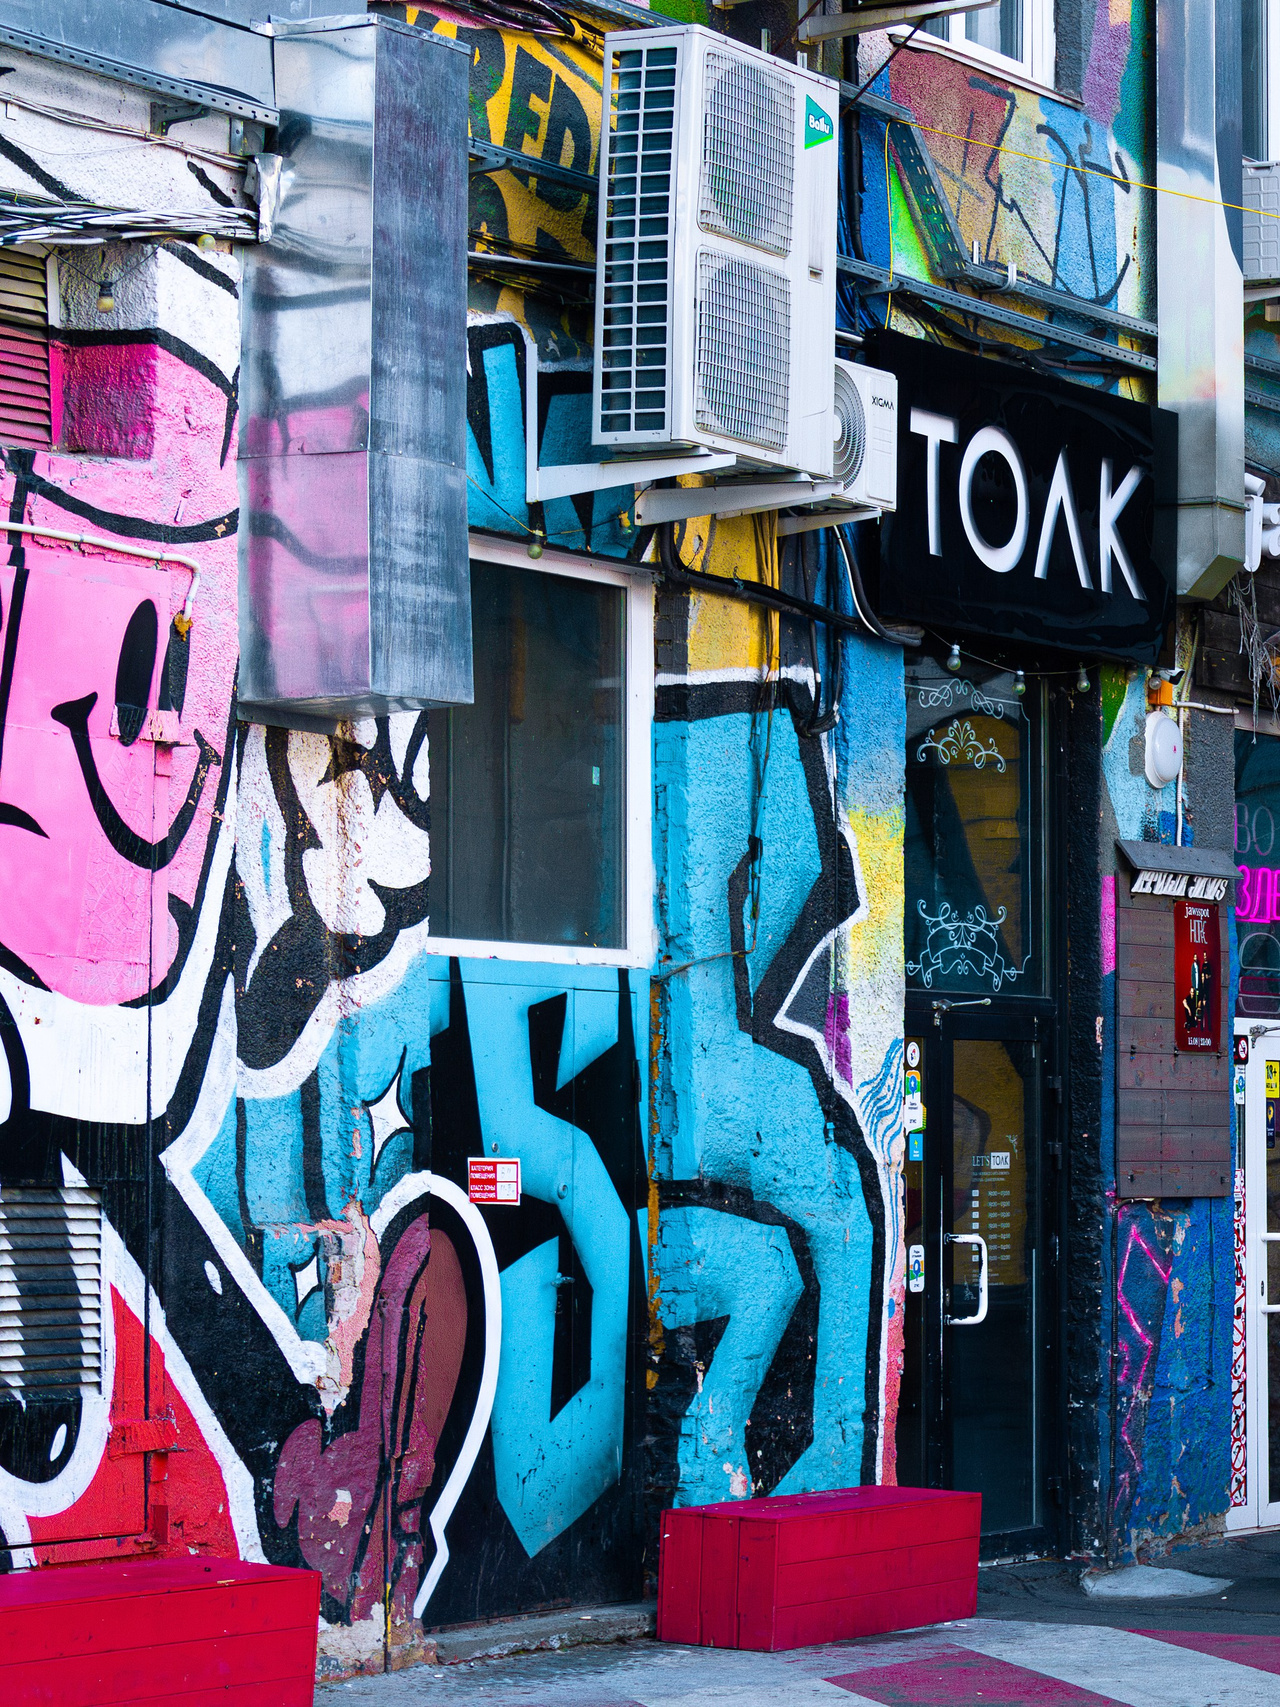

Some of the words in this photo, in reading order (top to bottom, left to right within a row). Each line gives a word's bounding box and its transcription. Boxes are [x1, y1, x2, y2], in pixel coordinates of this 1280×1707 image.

[809, 114, 830, 134] Ballu
[871, 396, 895, 411] XIGMA
[1184, 903, 1210, 920] jawsspot
[1266, 1064, 1278, 1080] 18+
[971, 1155, 990, 1167] LET'S
